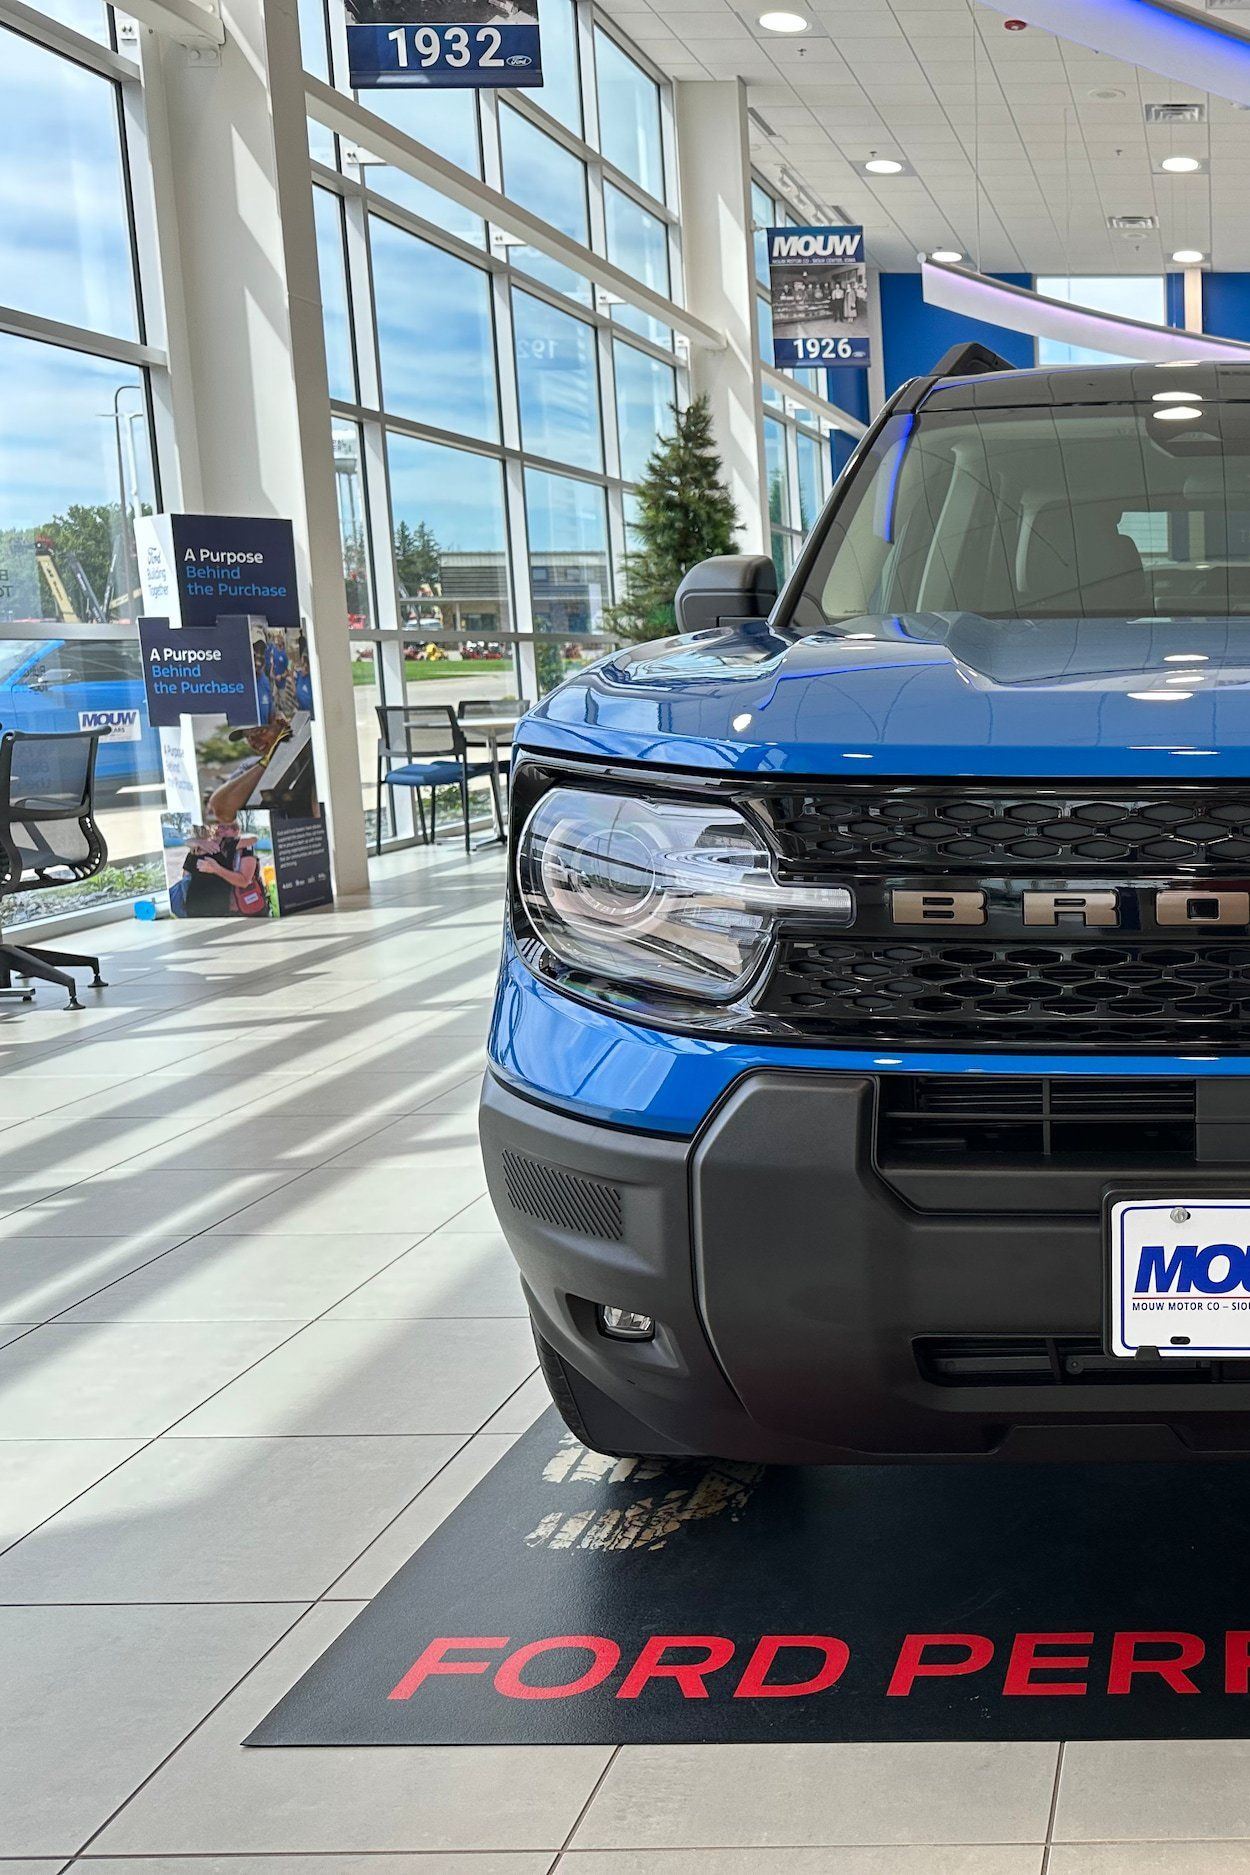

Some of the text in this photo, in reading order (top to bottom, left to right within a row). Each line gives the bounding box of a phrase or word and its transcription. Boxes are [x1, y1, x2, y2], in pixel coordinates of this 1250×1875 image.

[388, 27, 504, 67] 1932
[772, 235, 861, 257] MOUW
[793, 338, 852, 358] 1926
[184, 548, 264, 565] A Purpose
[186, 566, 241, 579] Behind
[187, 583, 287, 597] the Purchase
[150, 648, 222, 663] A Purpose
[152, 664, 201, 678] Behind
[154, 681, 245, 694] the Purchase
[82, 711, 137, 727] MOUW
[1132, 1302, 1165, 1311] MOUW
[1168, 1302, 1203, 1311] MOTOR
[1207, 1302, 1220, 1311] CO
[386, 1633, 851, 1700] FORD
